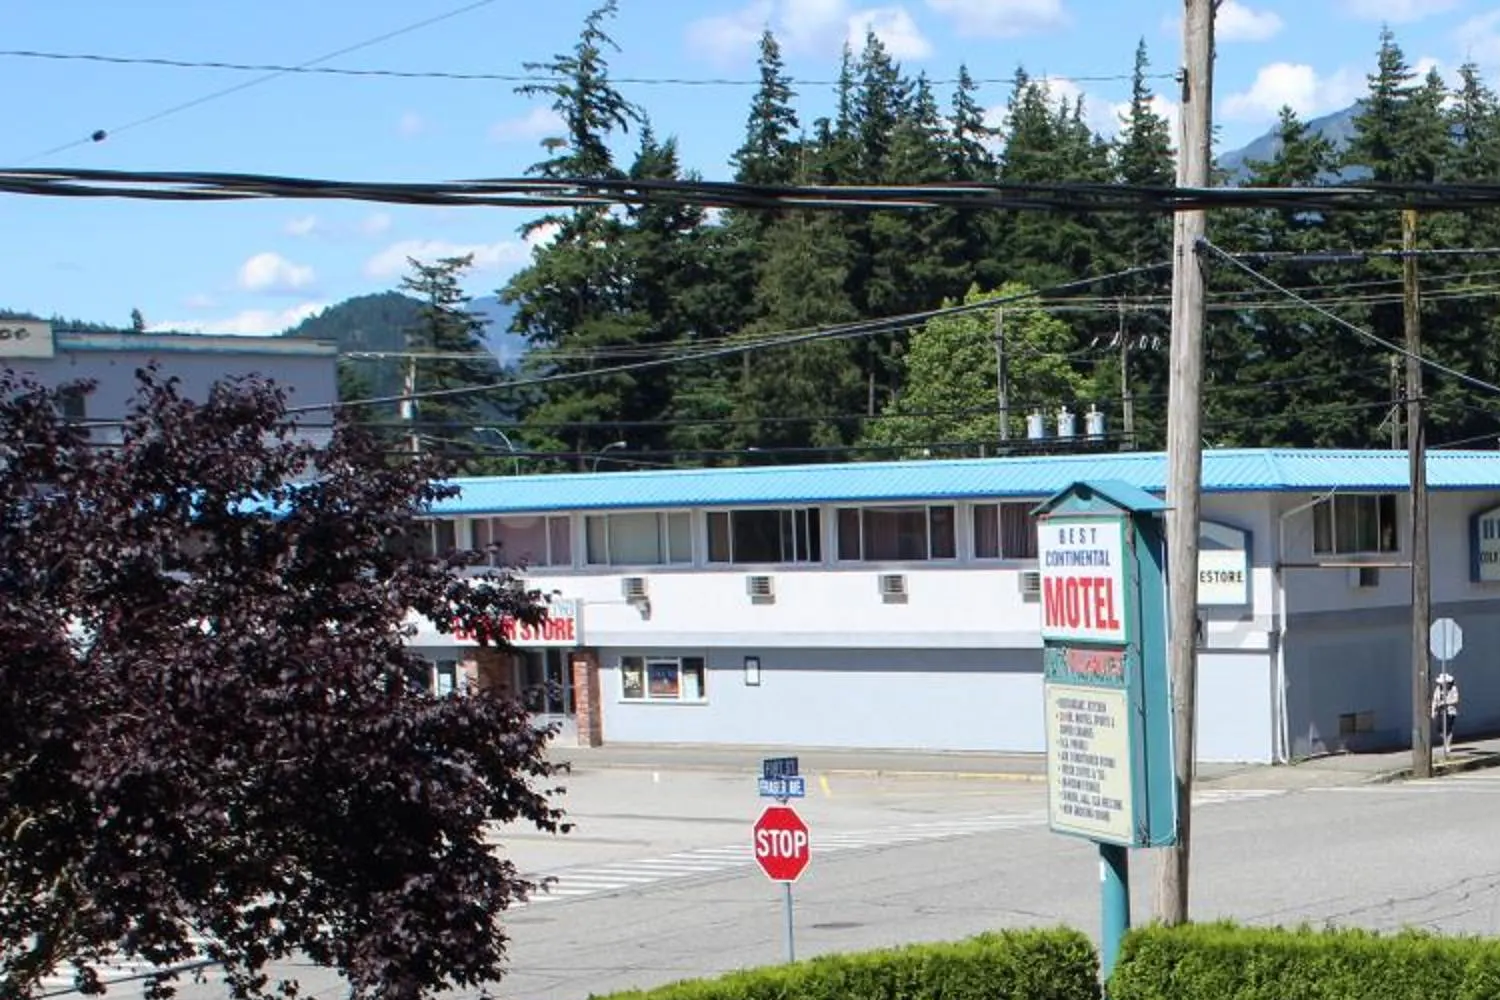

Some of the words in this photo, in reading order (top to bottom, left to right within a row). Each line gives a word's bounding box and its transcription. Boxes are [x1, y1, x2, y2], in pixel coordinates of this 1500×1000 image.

[1059, 527, 1097, 545] BEST
[1043, 576, 1120, 629] MOTEL
[757, 829, 807, 858] STOP
